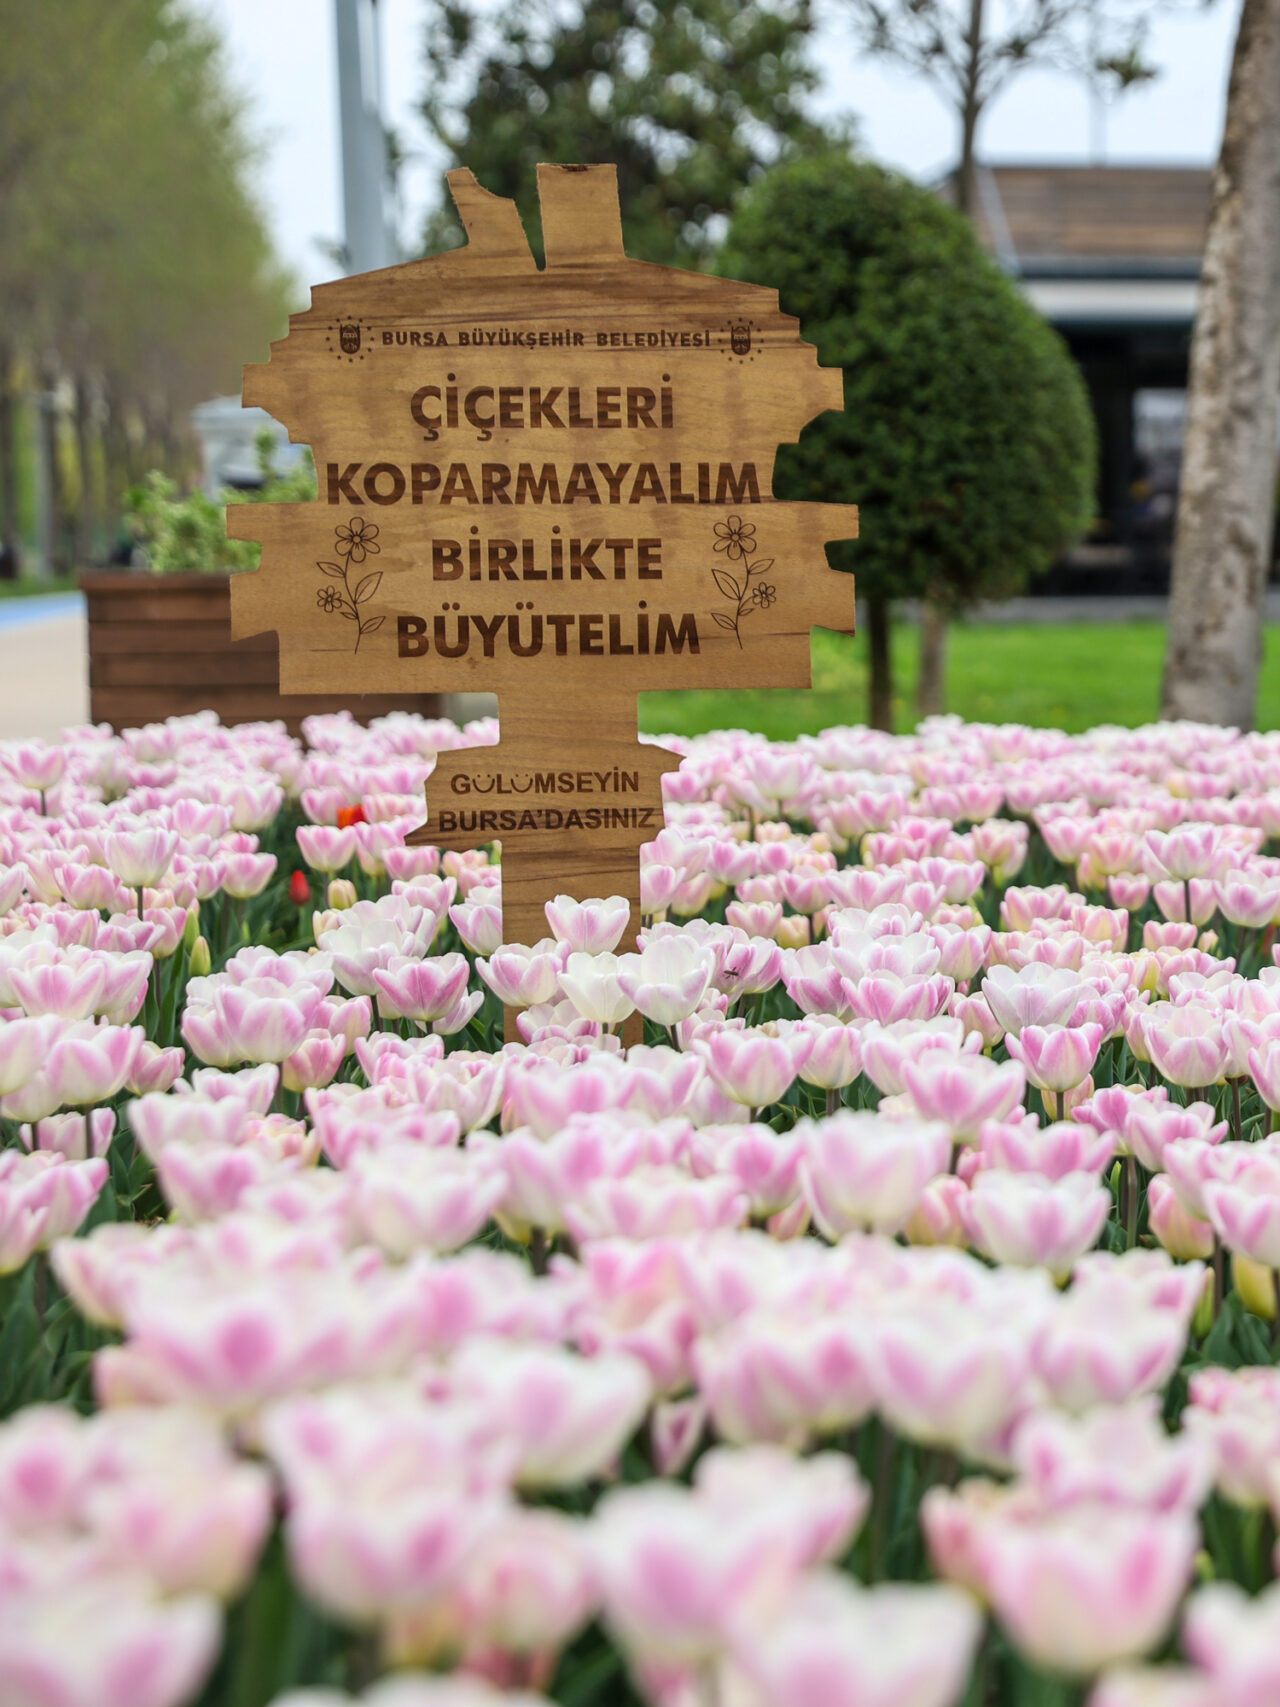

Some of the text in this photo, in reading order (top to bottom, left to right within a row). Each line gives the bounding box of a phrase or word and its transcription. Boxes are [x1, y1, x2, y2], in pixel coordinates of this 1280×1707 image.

[381, 328, 711, 349] BURSA BÜYÜKŞEHİR BELEDİYESİ
[410, 372, 674, 442] ÇİÇEKLERİ
[326, 462, 761, 506] KOPARMAYALIM
[432, 525, 663, 582] BİRLİKTE
[397, 600, 700, 658] BÜYÜTELİM
[450, 766, 639, 795] GÜLÜMSEYİN
[438, 807, 656, 832] BURSA'DASINIZ
